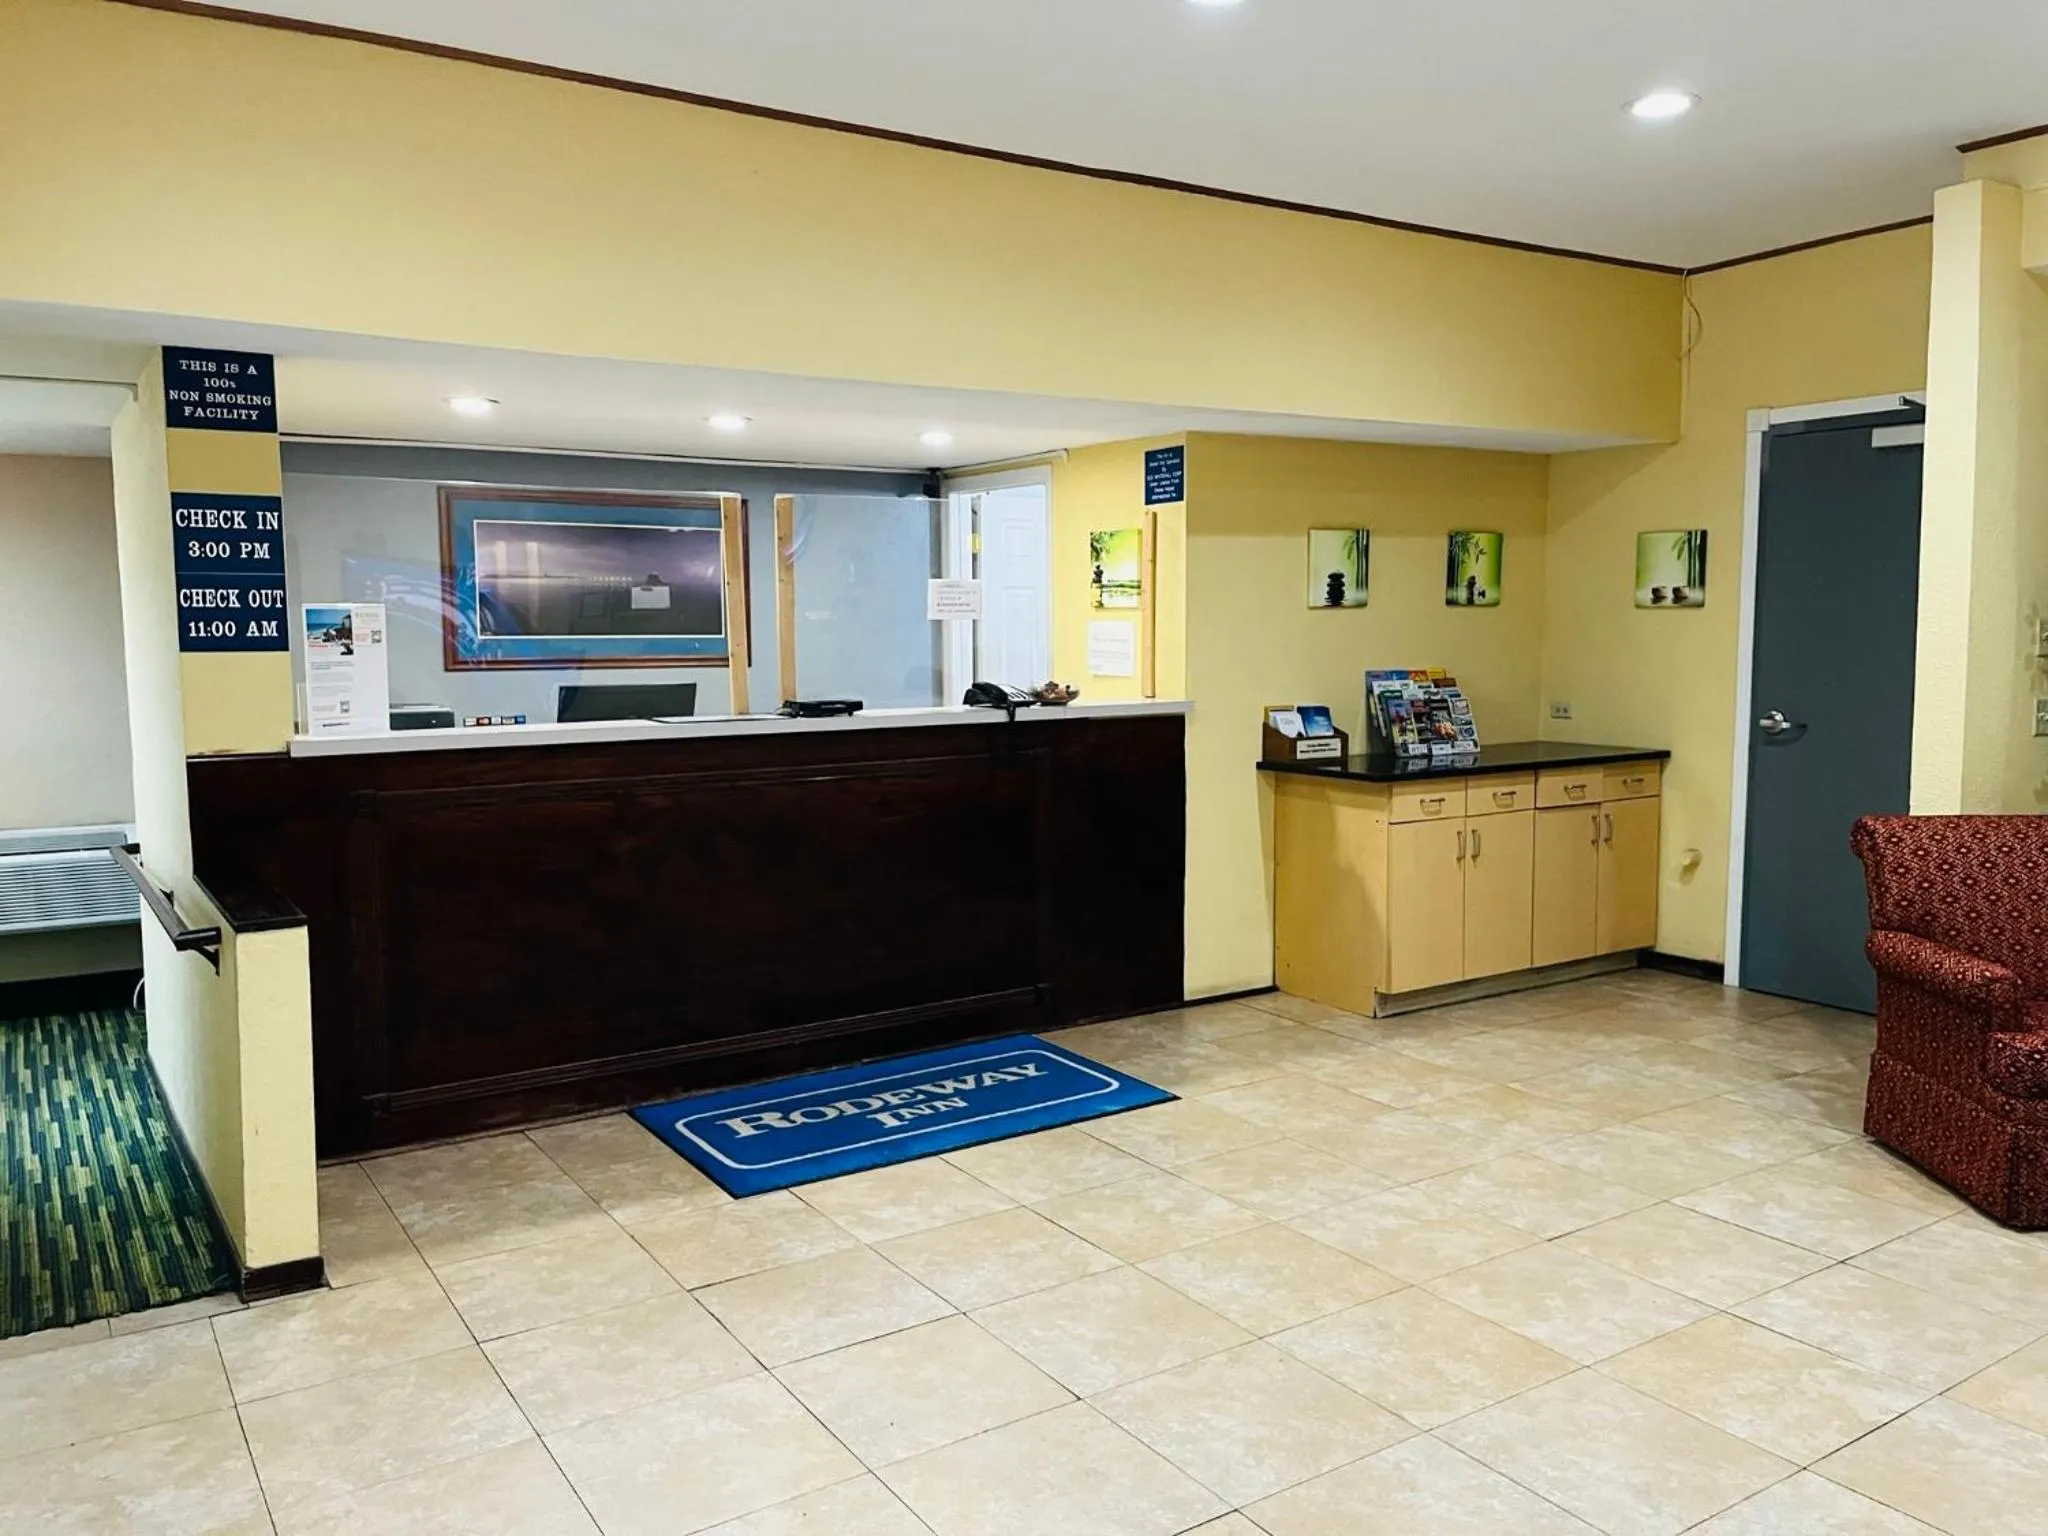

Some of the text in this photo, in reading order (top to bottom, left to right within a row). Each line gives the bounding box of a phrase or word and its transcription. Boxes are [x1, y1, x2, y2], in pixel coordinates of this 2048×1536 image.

[179, 360, 258, 375] THIS IS A
[169, 390, 272, 406] NON SMOKING
[183, 406, 260, 420] FACILITY
[175, 509, 280, 529] CHECK IN
[188, 541, 271, 559] 3:00 PM
[179, 588, 284, 608] CHECK OUT
[188, 621, 279, 638] 11:00 AM
